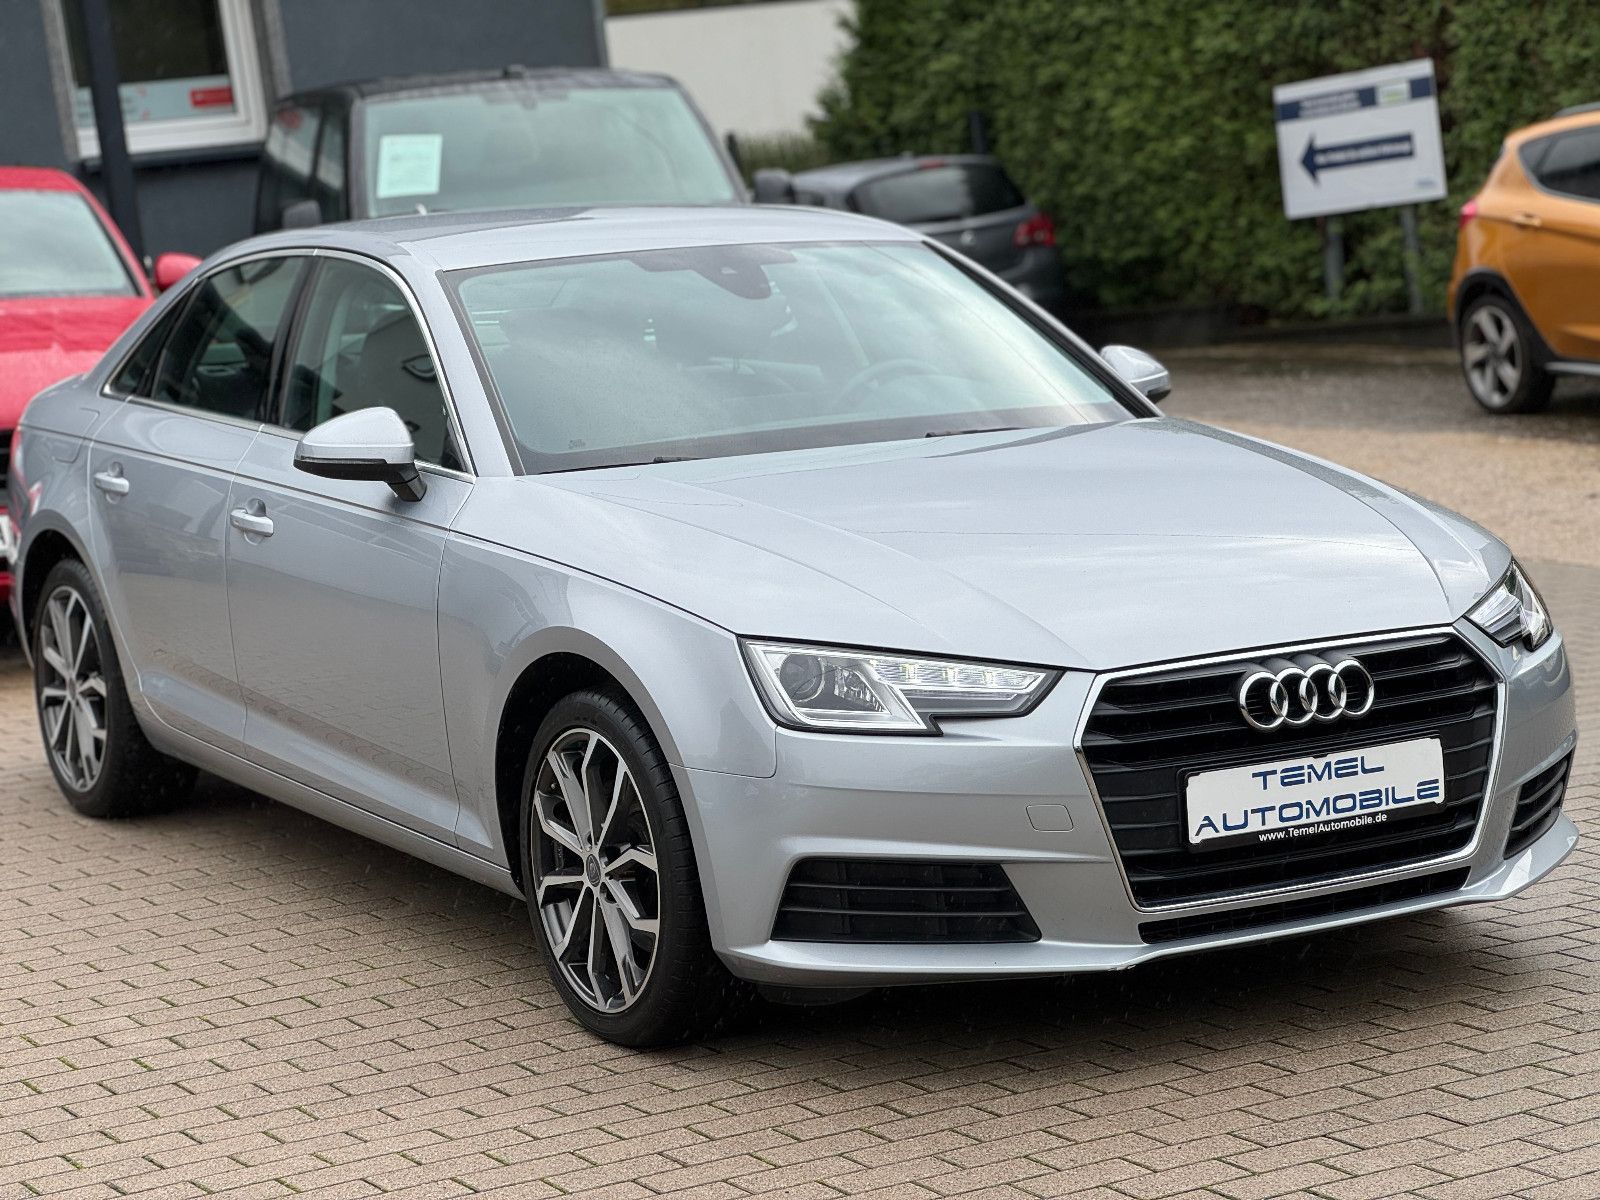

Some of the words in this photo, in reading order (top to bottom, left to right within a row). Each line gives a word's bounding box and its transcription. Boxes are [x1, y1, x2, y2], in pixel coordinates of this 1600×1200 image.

[1252, 755, 1384, 790] TEMEL
[1194, 778, 1440, 837] AUTOMOBILE
[1258, 812, 1388, 842] www.TemelAutomobile.de
